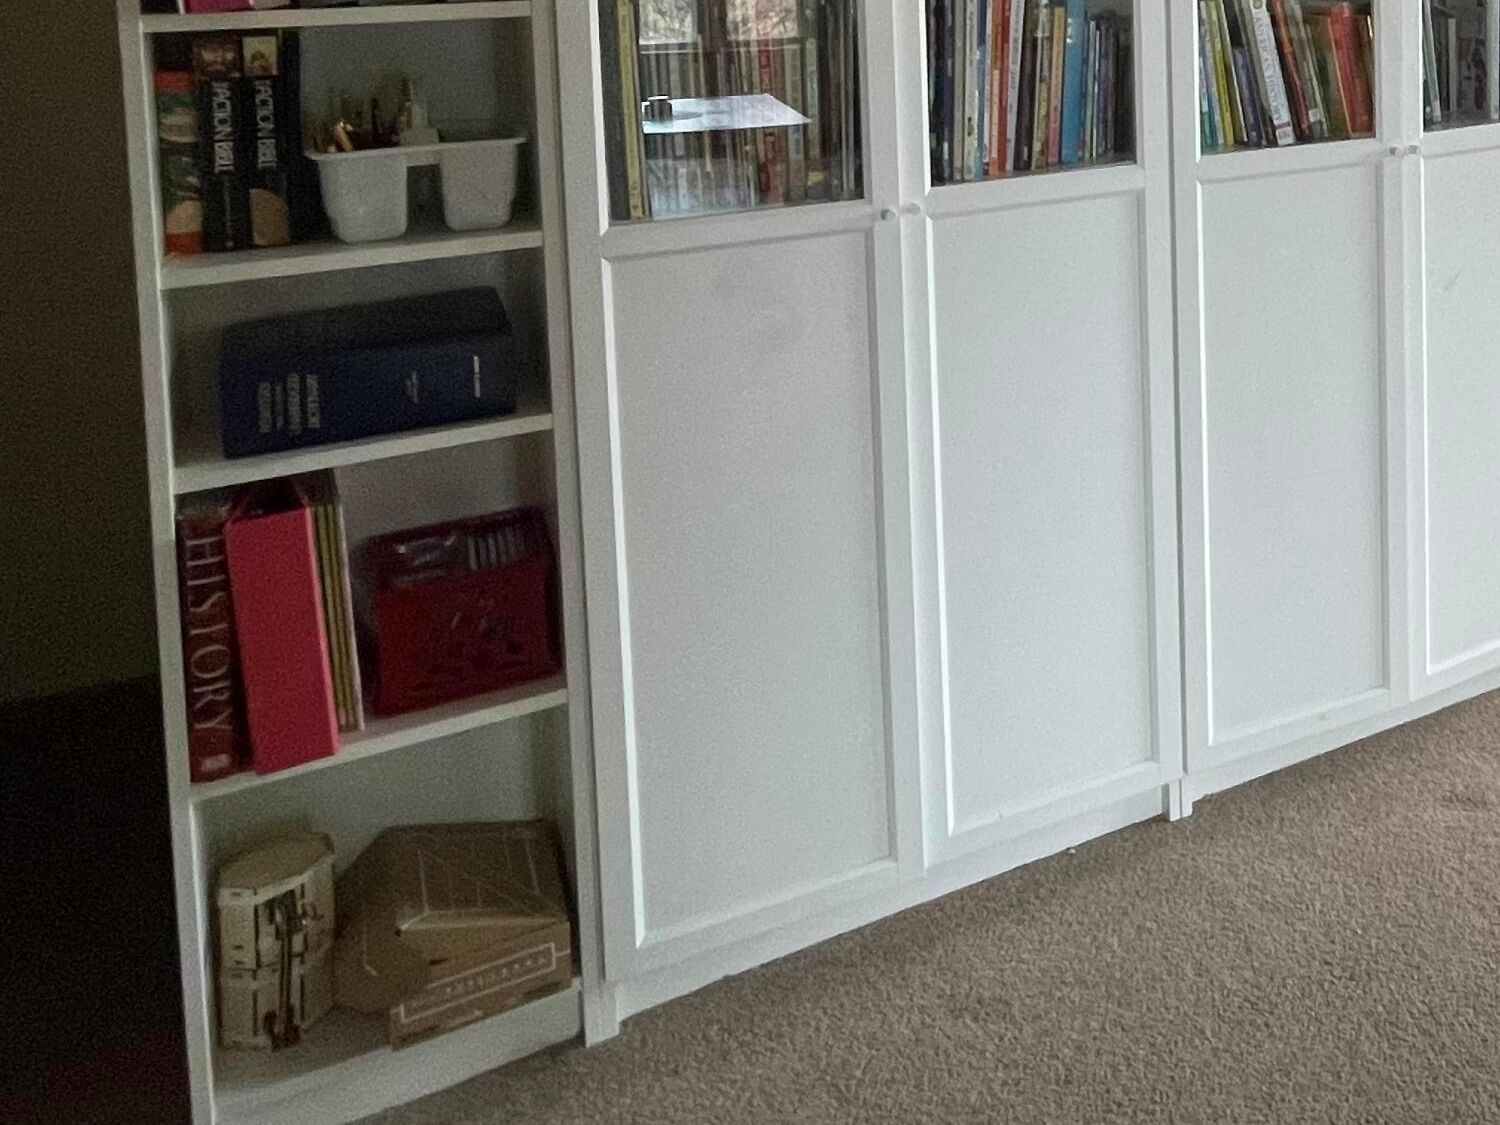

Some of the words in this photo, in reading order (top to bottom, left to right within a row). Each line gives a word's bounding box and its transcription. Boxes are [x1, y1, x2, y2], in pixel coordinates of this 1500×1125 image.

[213, 87, 233, 140] ACTION
[254, 86, 275, 137] ACTION
[186, 535, 233, 730] HISTORY
